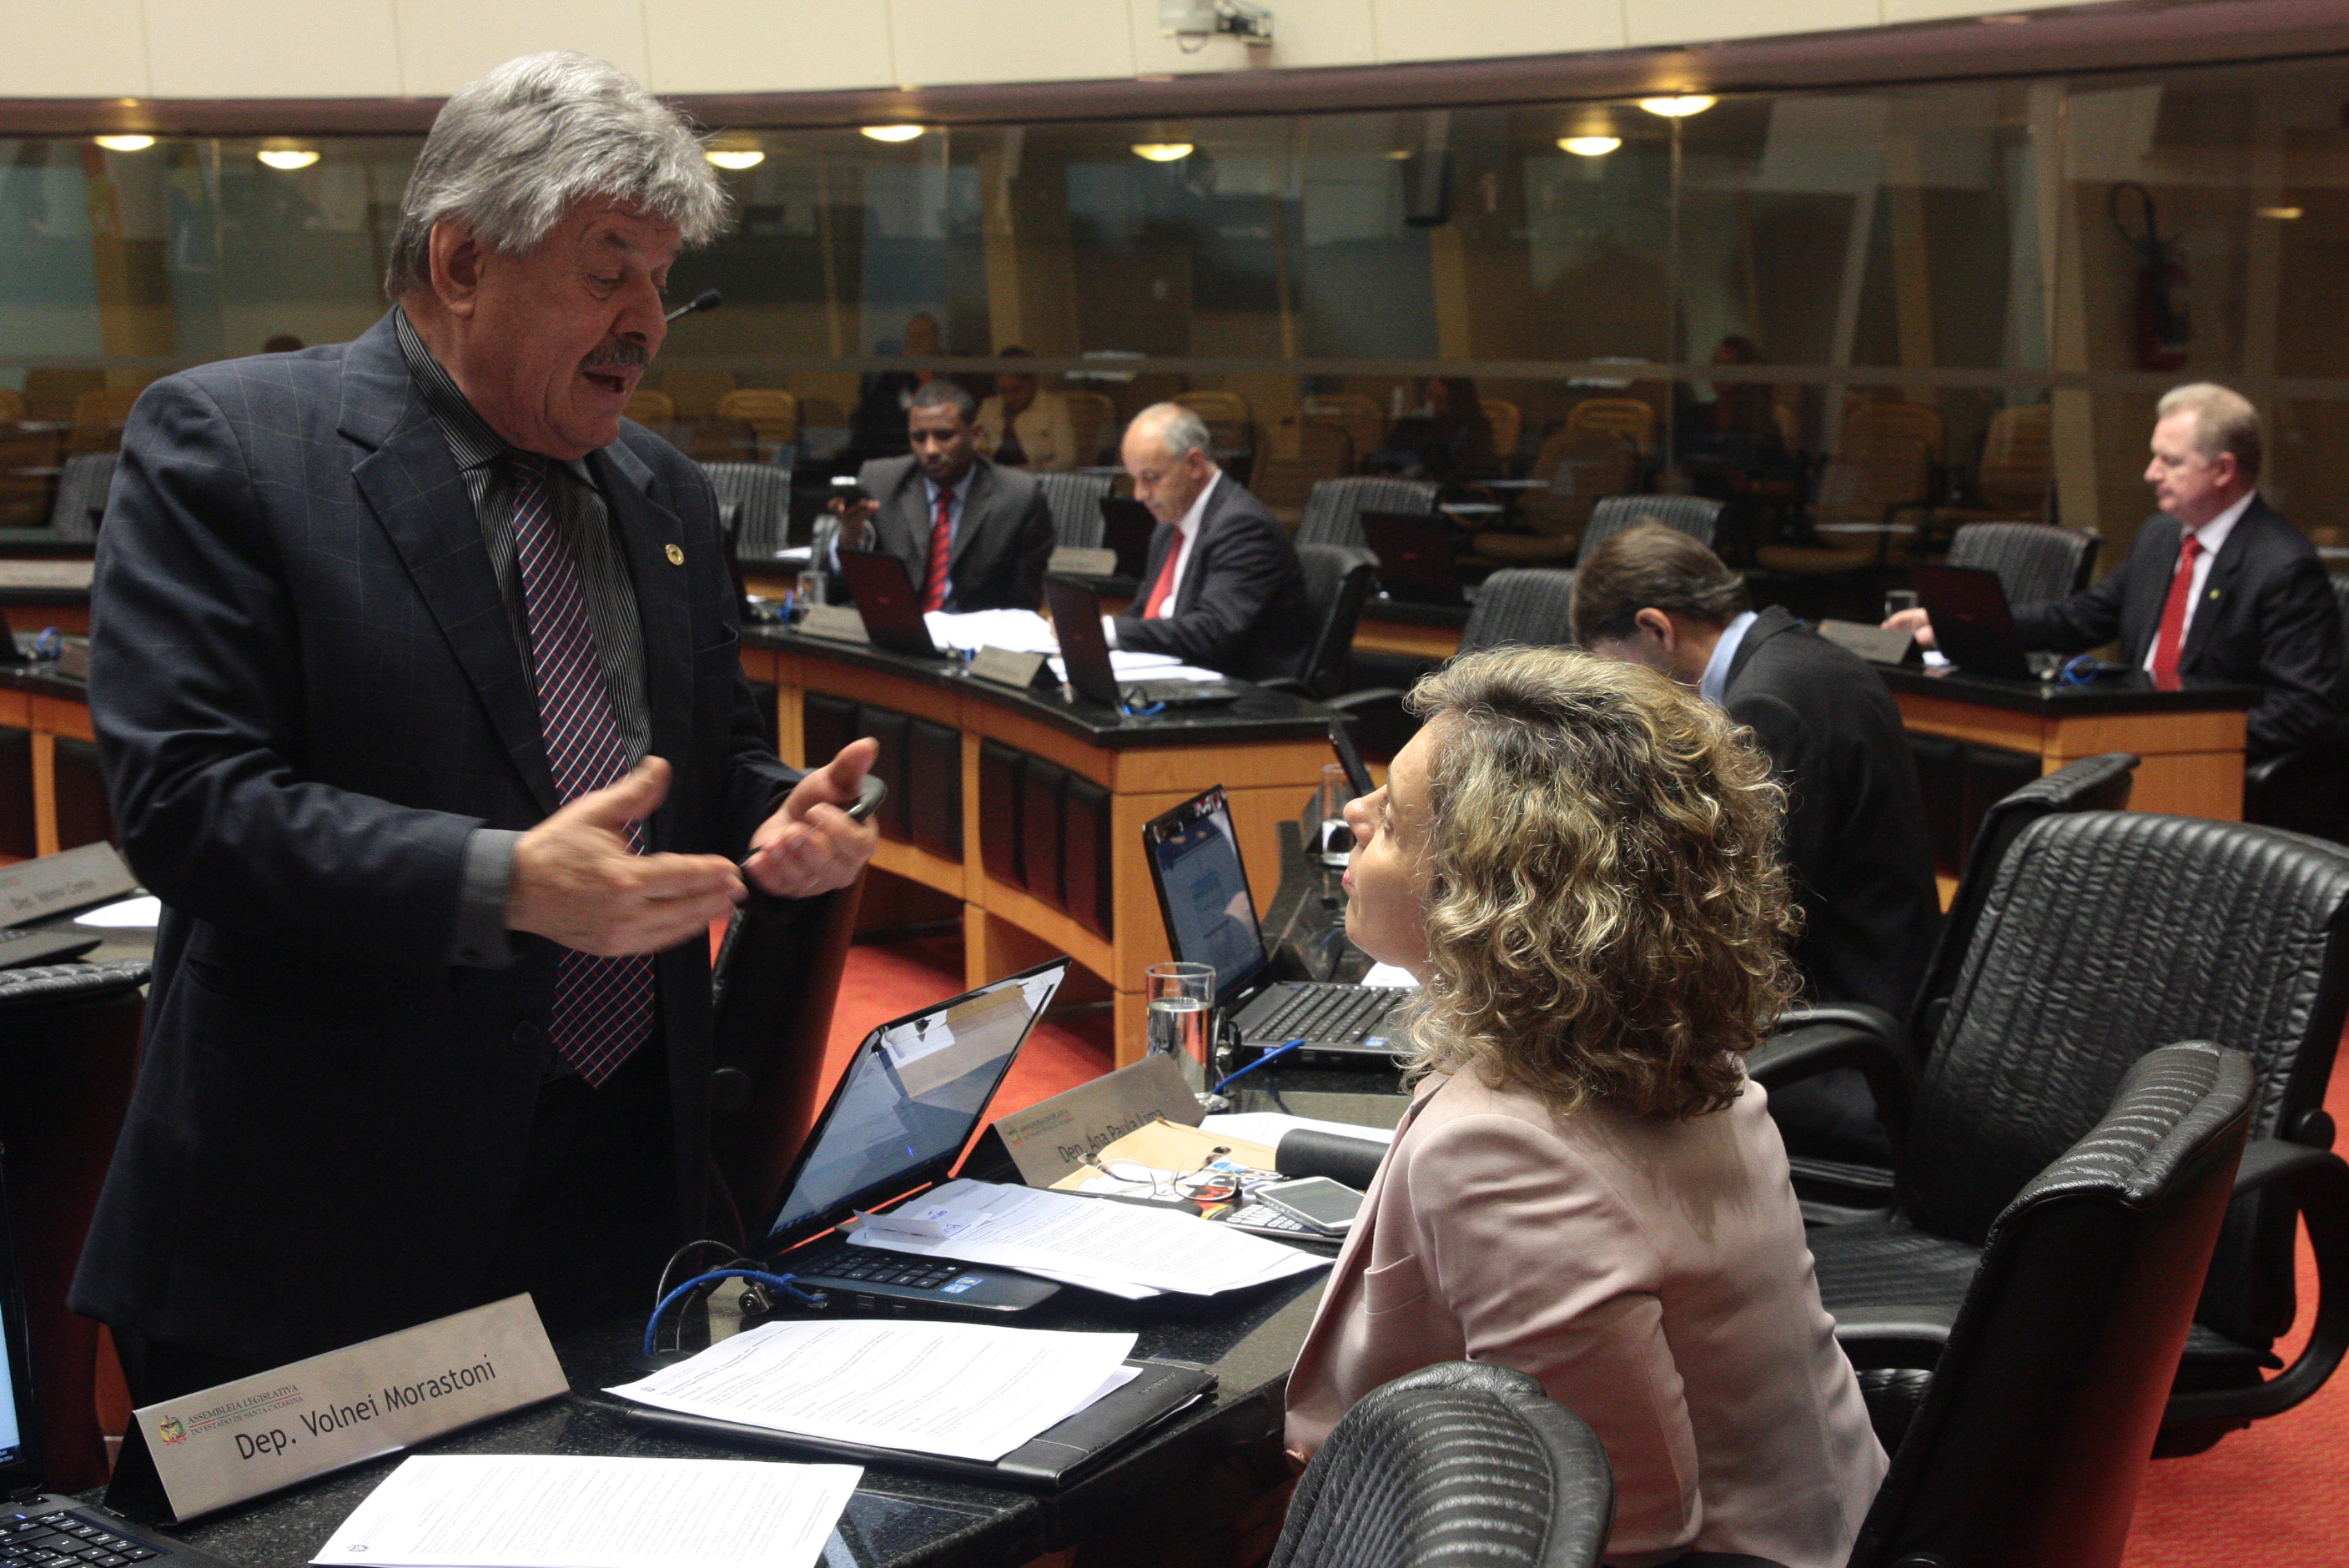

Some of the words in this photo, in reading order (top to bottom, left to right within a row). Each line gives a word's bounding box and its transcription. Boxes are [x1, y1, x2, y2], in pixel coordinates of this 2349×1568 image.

[1087, 1132, 1110, 1150] Ana
[1107, 1118, 1138, 1140] Paula
[188, 1402, 243, 1425] ASSEMBLEIA
[243, 1385, 299, 1410] LEGISLATIVA
[191, 1426, 204, 1436] DO
[204, 1417, 233, 1433] ESTADO
[234, 1415, 243, 1423] DE
[243, 1408, 268, 1420] SANTA
[268, 1396, 304, 1412] CATARINA
[234, 1429, 297, 1460] Dep.
[299, 1393, 380, 1437] Volnei
[384, 1354, 496, 1413] Morastoni
